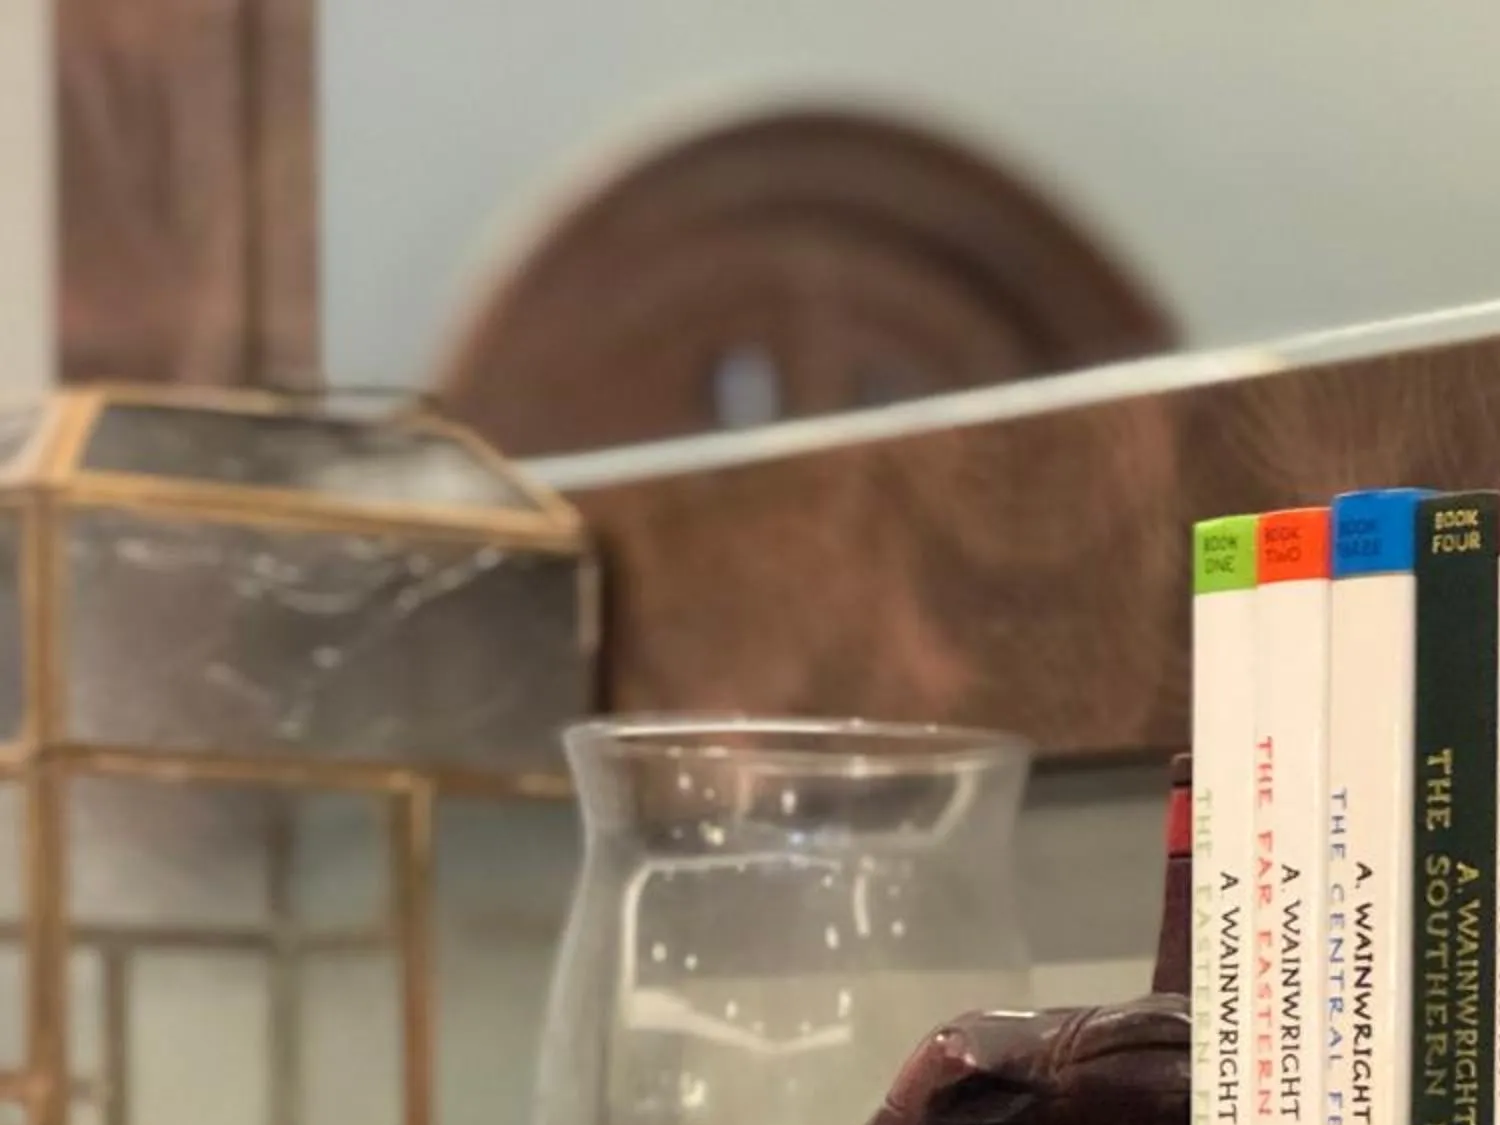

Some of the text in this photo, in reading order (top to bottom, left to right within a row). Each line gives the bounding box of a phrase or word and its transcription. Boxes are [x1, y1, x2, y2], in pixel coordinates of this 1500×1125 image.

[1432, 531, 1481, 553] FOUR
[1435, 509, 1478, 530] BOOK
[1256, 735, 1273, 809] THE
[1426, 747, 1452, 832] THE
[1330, 786, 1348, 860] THE
[1256, 830, 1274, 906] FAR
[1217, 906, 1241, 1125] WAINWRIGHT
[1280, 899, 1303, 1122] WAINWRIGHT
[1326, 882, 1346, 1070] CENTRAL
[1424, 854, 1451, 1097] SOUTHERN
[1256, 929, 1273, 1117] EASTERN
